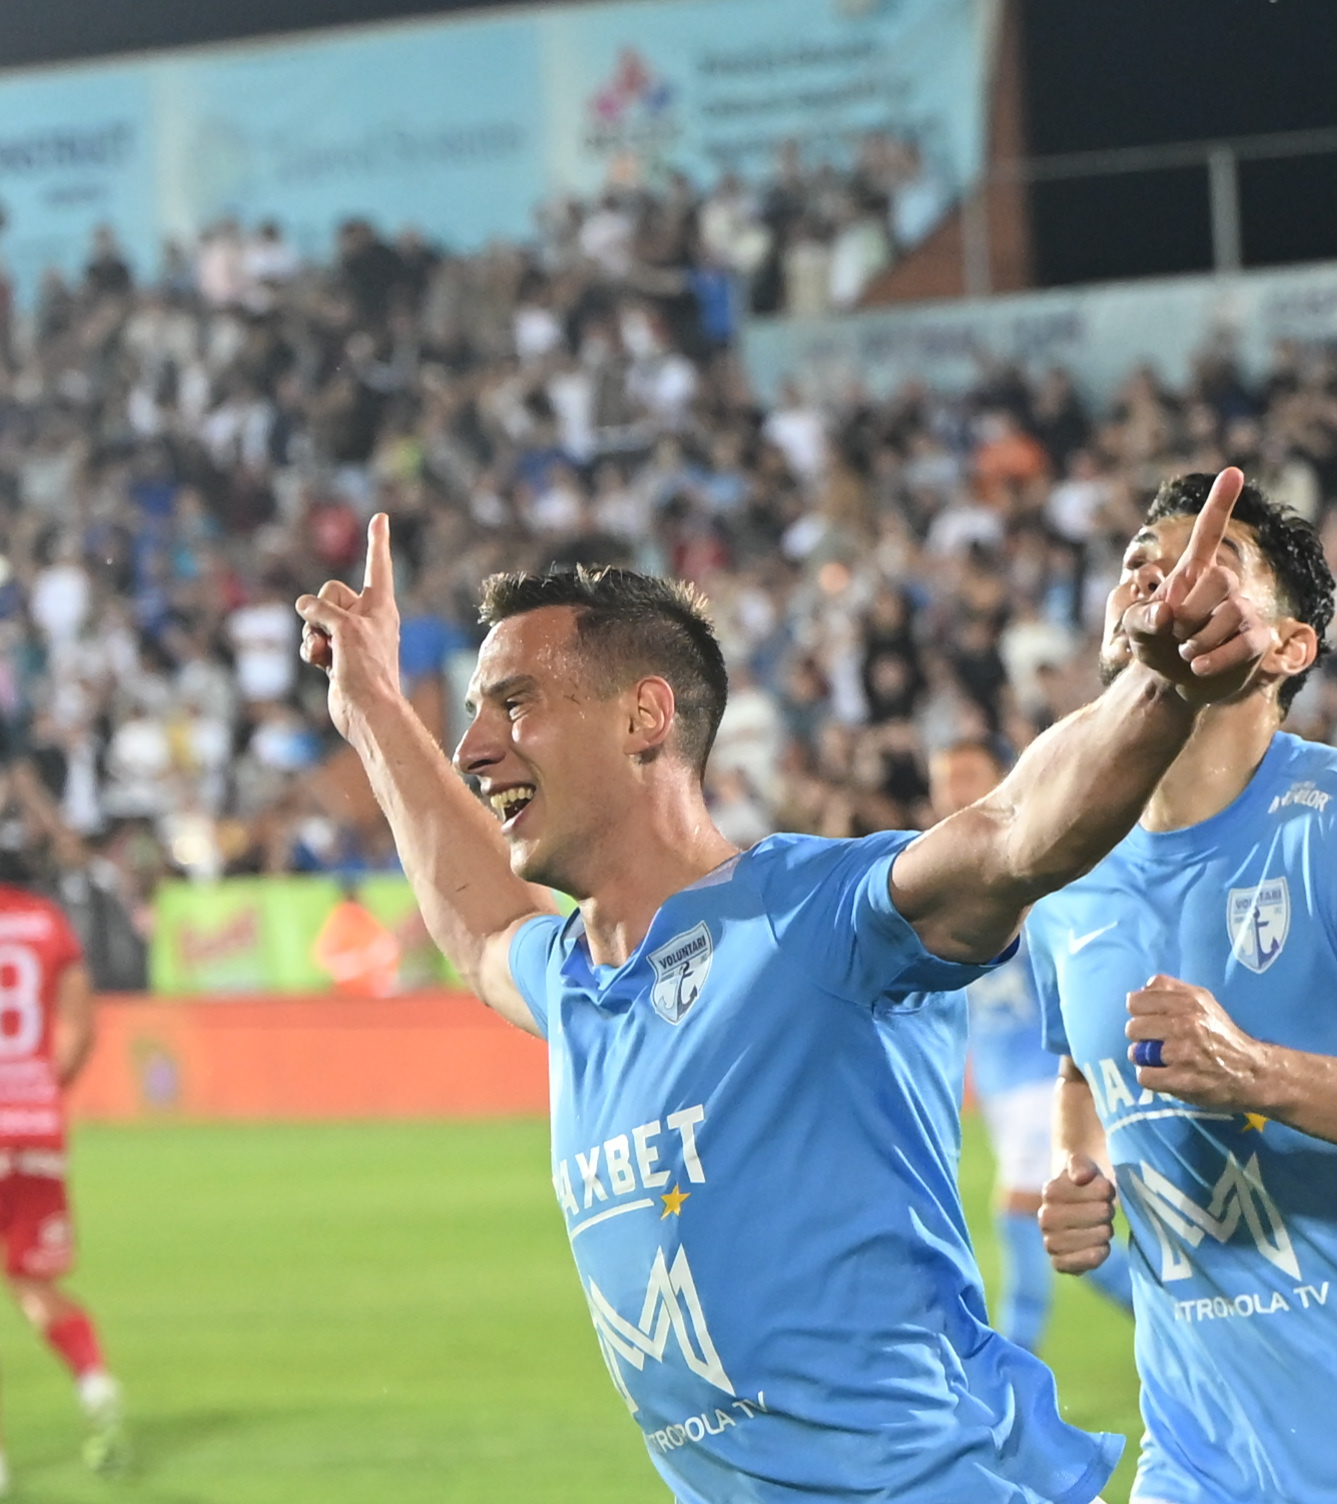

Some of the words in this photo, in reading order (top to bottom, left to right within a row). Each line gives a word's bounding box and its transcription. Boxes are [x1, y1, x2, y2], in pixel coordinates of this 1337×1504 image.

[658, 934, 707, 969] VOLUNTARI
[552, 1104, 705, 1217] AXBET
[1174, 1292, 1290, 1322] TROOLA
[1293, 1281, 1329, 1309] TV
[731, 1390, 768, 1419] TV
